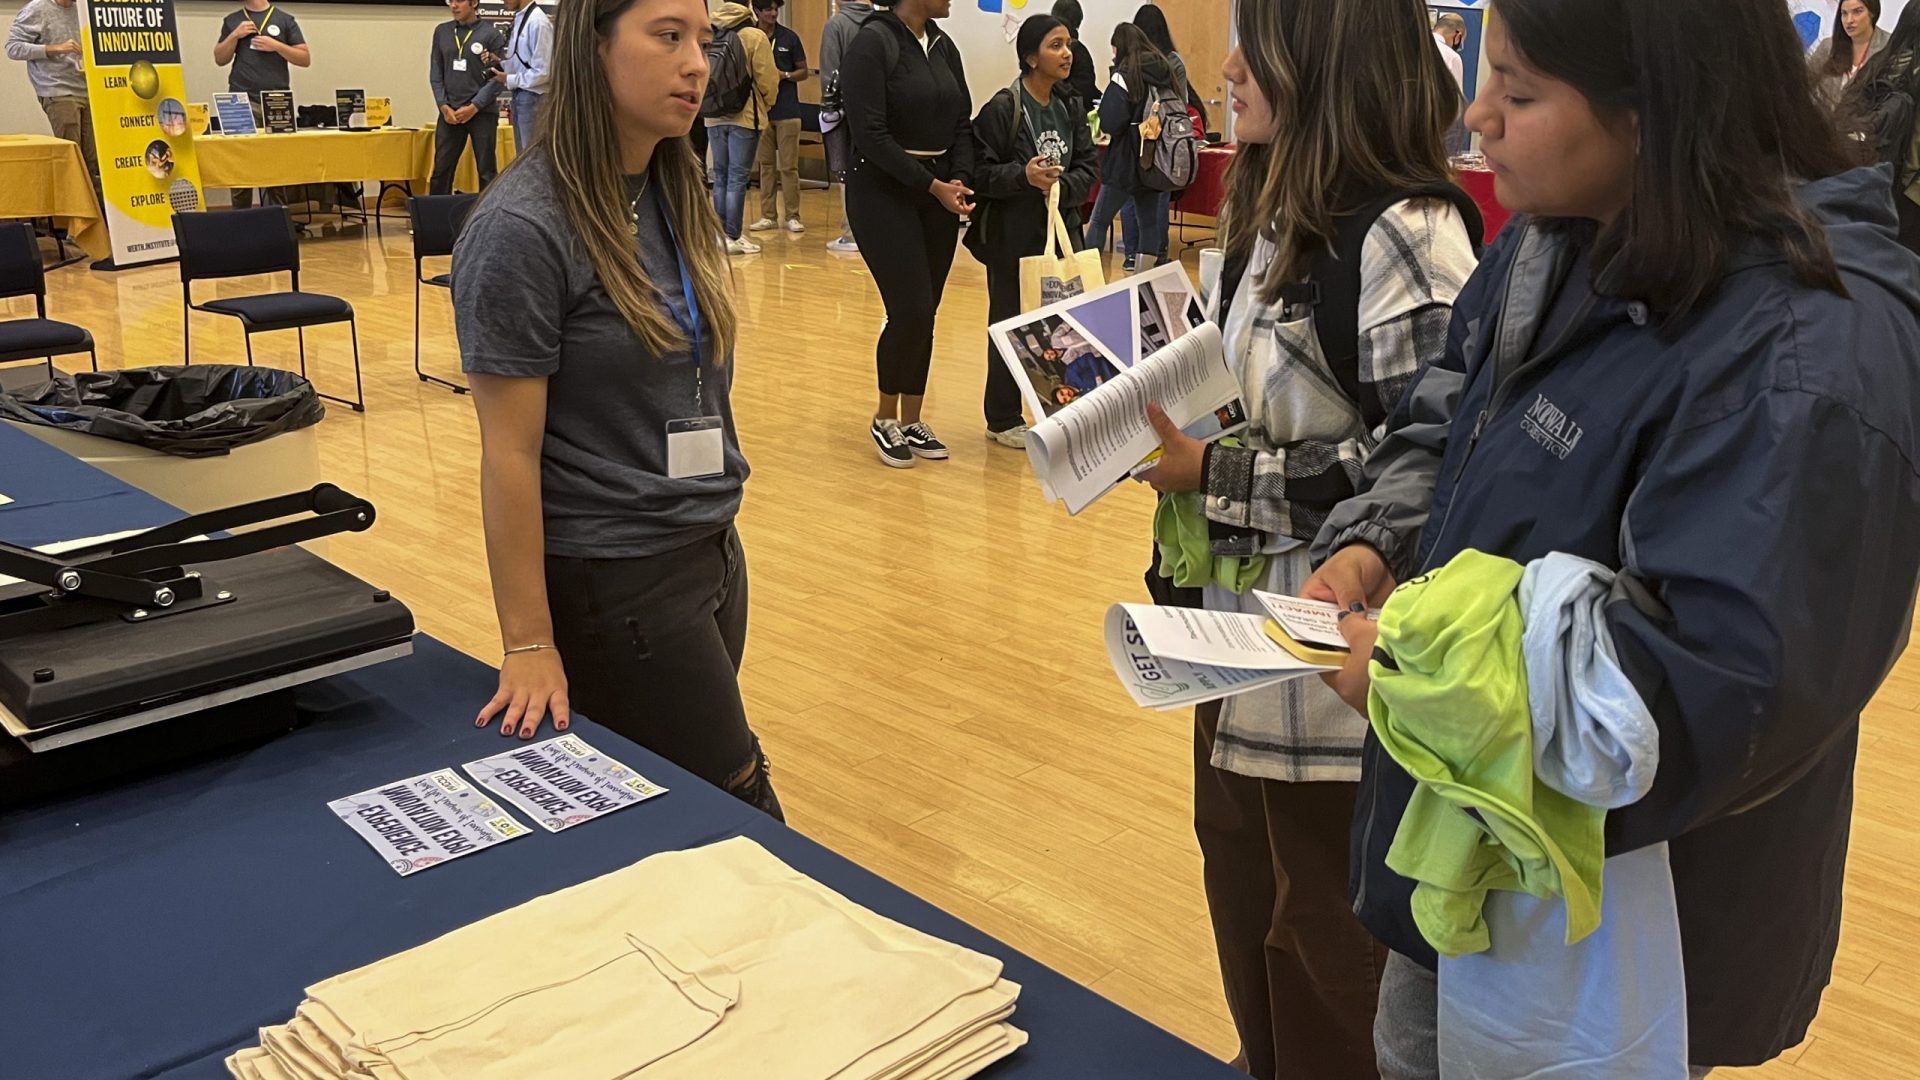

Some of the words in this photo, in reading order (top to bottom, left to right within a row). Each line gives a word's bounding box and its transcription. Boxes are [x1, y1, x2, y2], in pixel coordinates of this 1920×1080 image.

[94, 7, 145, 28] FUTURE
[145, 7, 164, 28] OF
[97, 31, 174, 52] INNOVATION
[104, 76, 128, 88] LEARN
[120, 114, 155, 128] CONNECT
[115, 155, 143, 169] CREATE
[130, 193, 166, 208] EXPLORE
[1126, 613, 1146, 646] SE
[1132, 653, 1162, 681] GET
